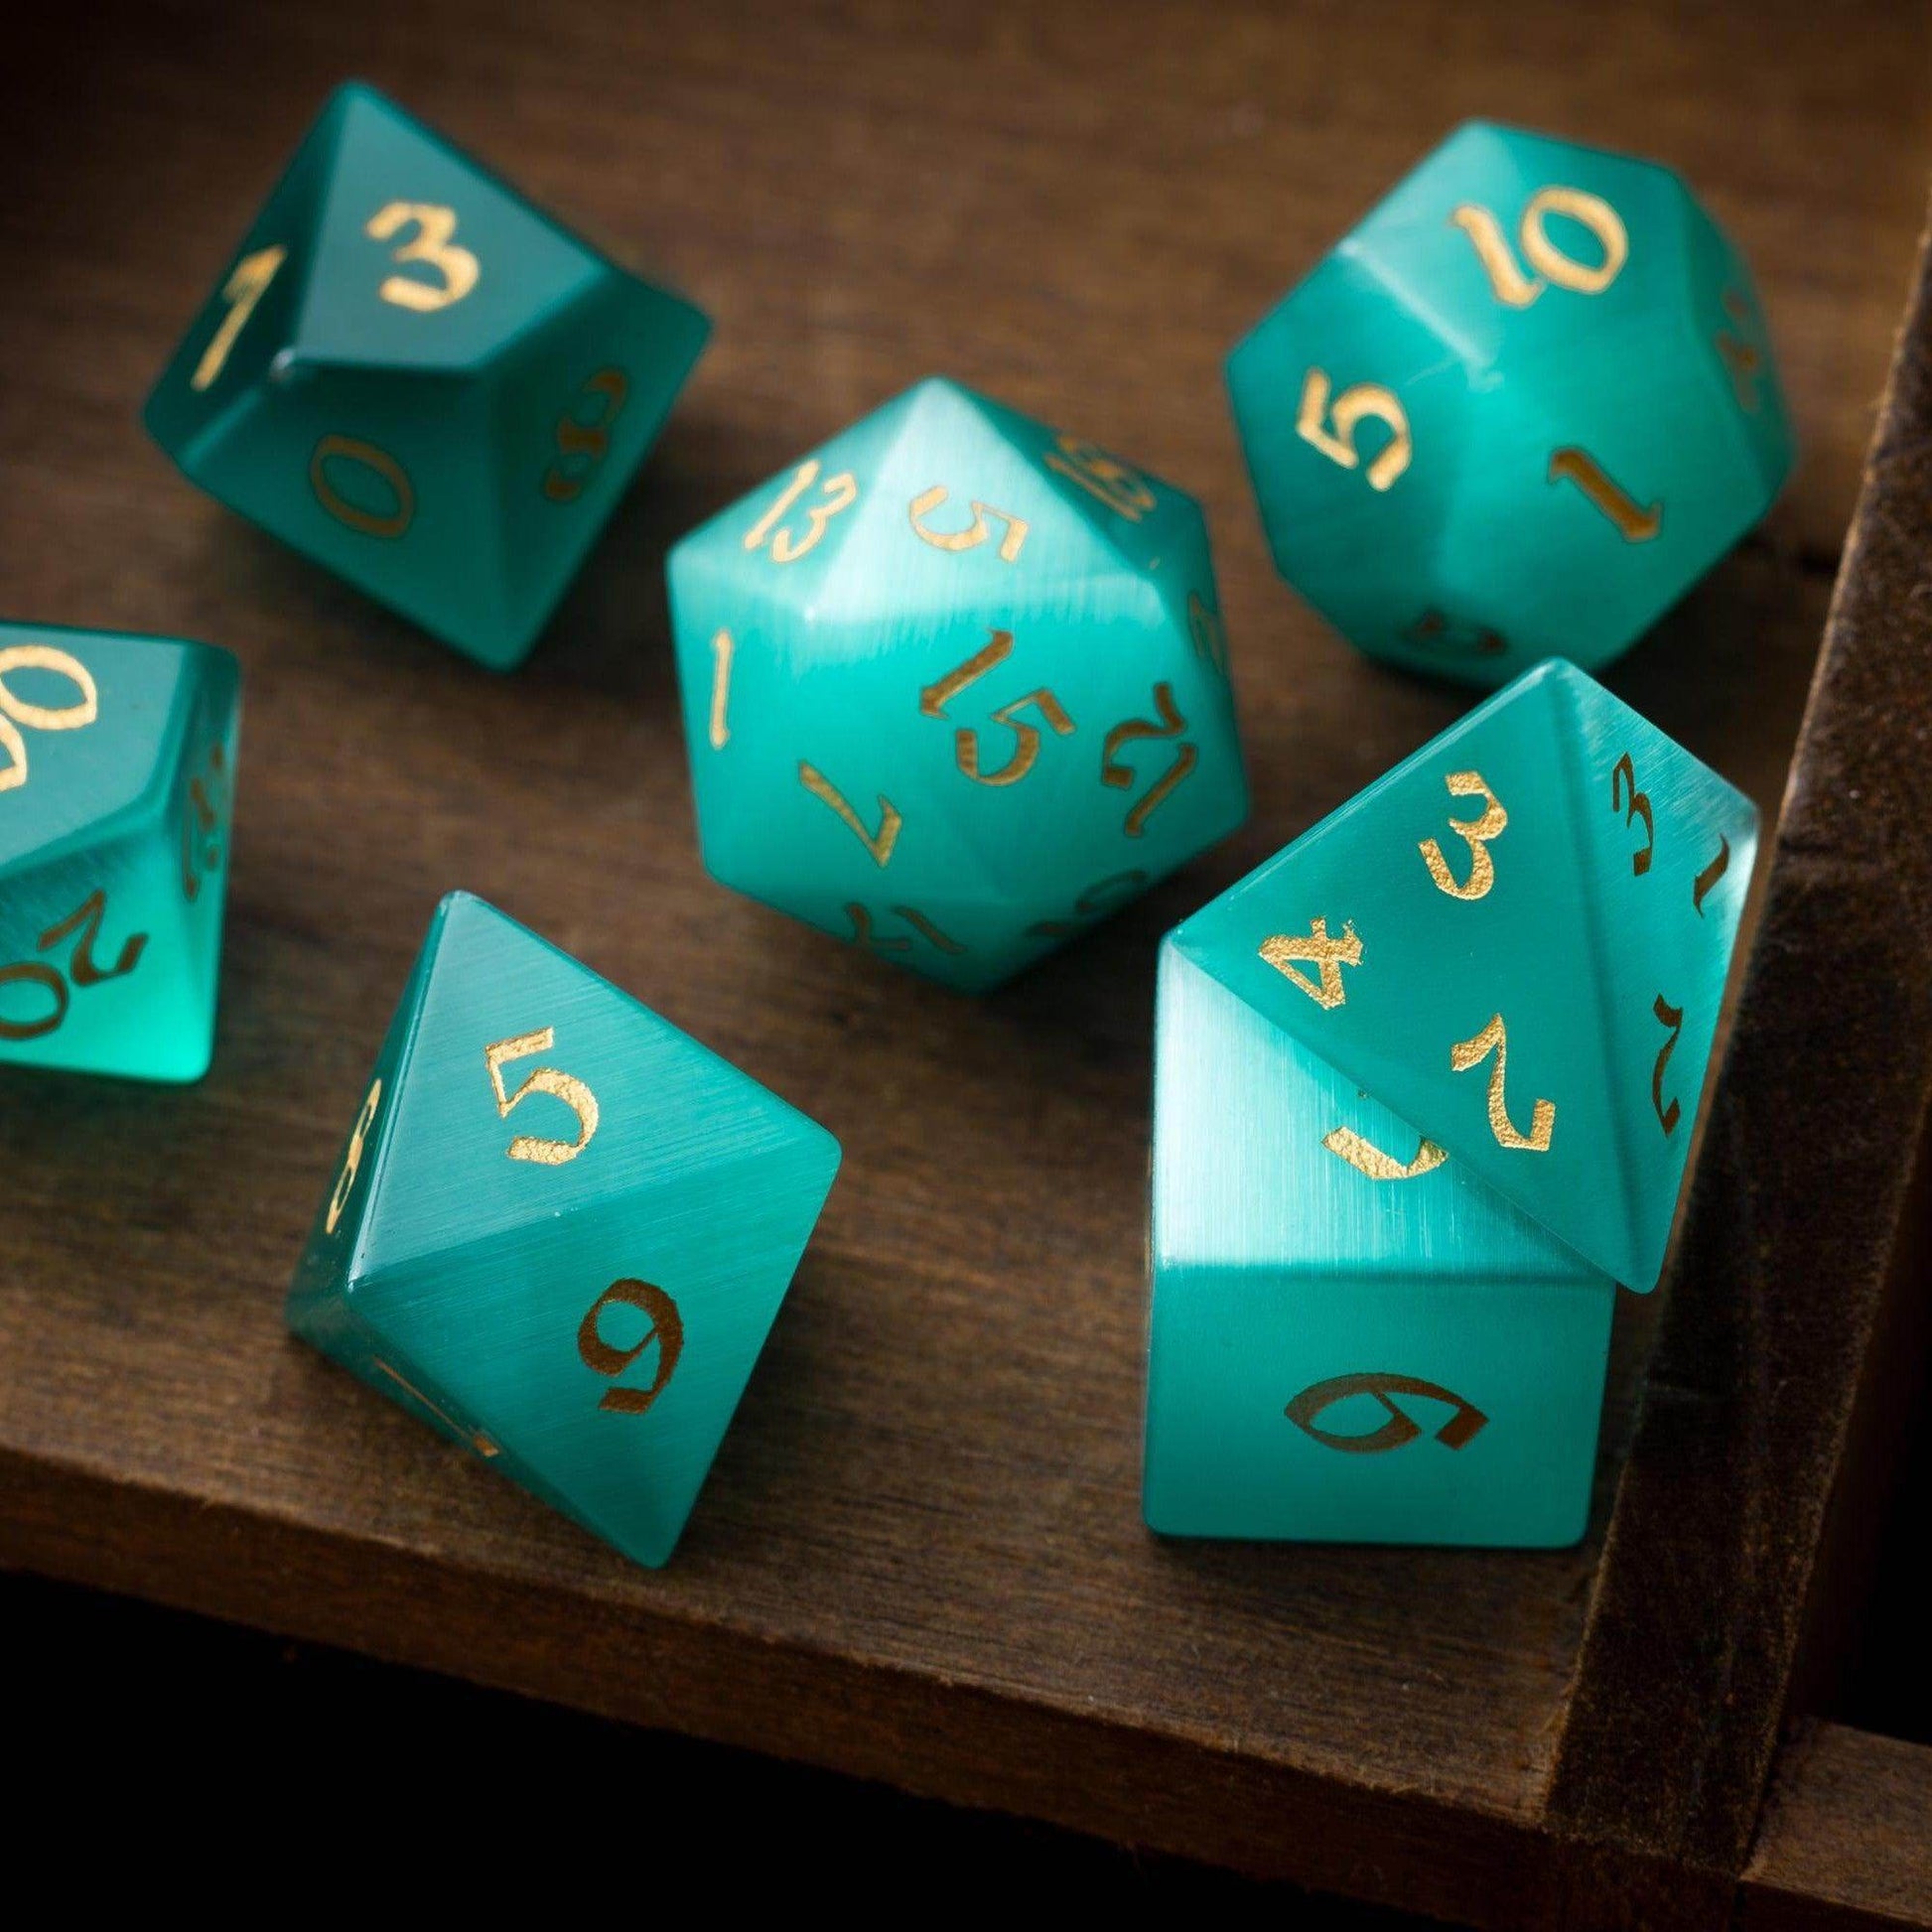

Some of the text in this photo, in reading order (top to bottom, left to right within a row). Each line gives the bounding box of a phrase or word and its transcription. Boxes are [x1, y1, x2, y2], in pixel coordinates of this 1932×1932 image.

[364, 200, 481, 313] 3
[1448, 185, 1630, 310] 10
[190, 242, 288, 390] 1
[310, 433, 415, 539] 0
[1295, 363, 1414, 492] 5
[743, 459, 859, 564] 13
[907, 483, 1031, 563] 5
[1548, 445, 1663, 542] 1
[709, 625, 733, 752] 1
[918, 627, 1077, 787] 15
[797, 759, 903, 869] 7
[1417, 770, 1508, 900] 3
[1611, 751, 1655, 878] 3
[1257, 914, 1364, 1011] 4
[485, 1026, 600, 1167] 5
[1450, 1012, 1558, 1153] 2
[1651, 993, 1683, 1138] 2
[325, 1077, 383, 1234] 8
